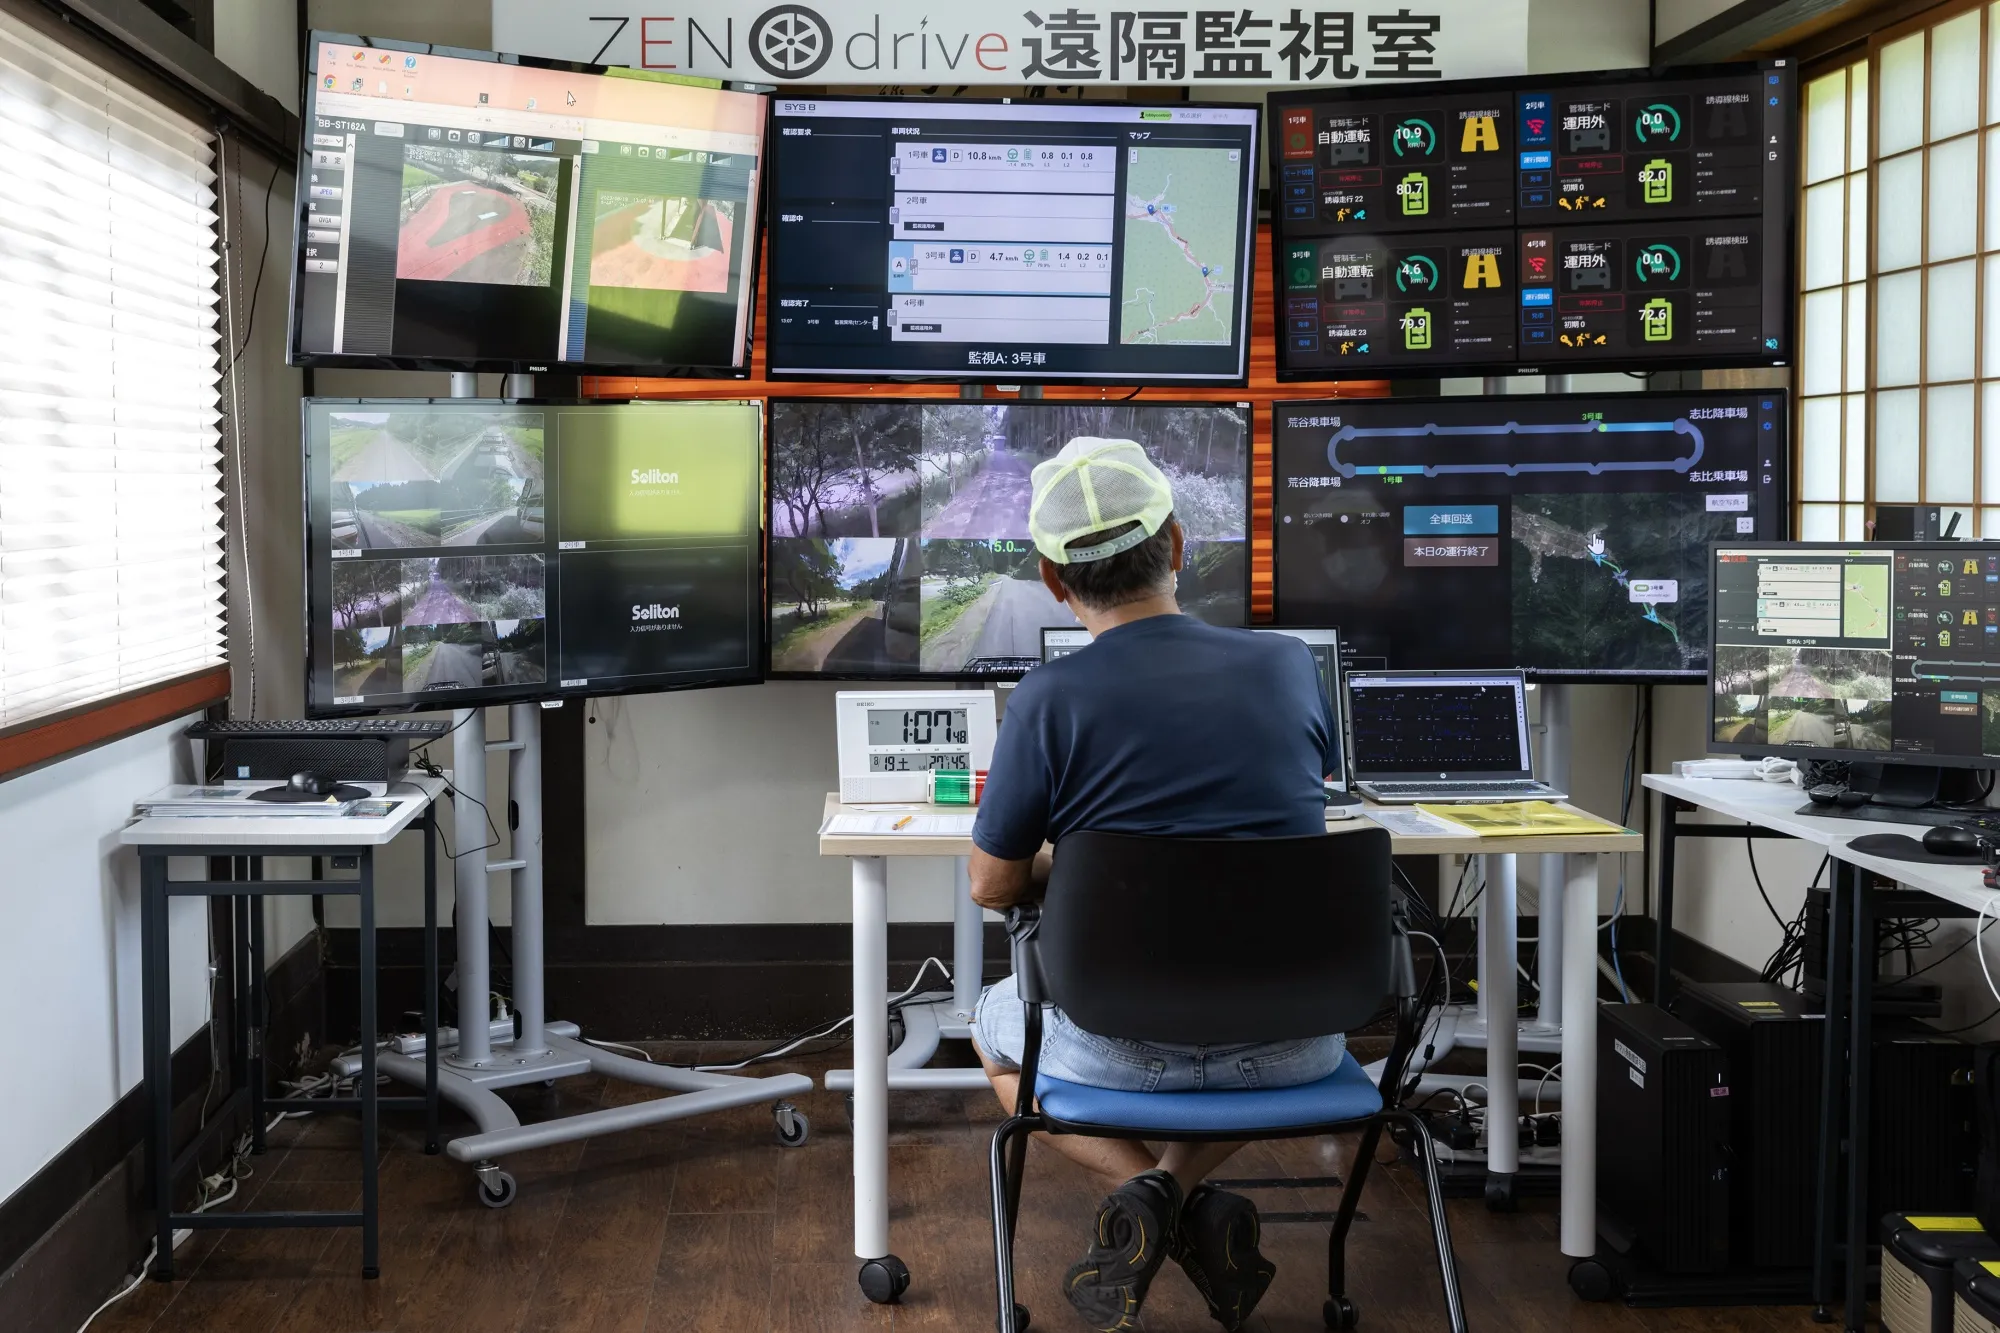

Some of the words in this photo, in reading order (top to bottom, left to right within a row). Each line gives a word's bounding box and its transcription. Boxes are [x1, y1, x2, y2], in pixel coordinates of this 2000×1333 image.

[588, 16, 733, 69] ZEN
[845, 14, 1009, 71] drive
[1021, 9, 1442, 81] 遠隔監視室
[1706, 94, 1749, 105] 誘導線検出
[784, 103, 806, 111] SYS
[1526, 102, 1545, 110] 2号車
[1569, 103, 1611, 113] 管制モード
[1288, 116, 1306, 124] 1号車
[1330, 118, 1368, 127] 管制モード
[1562, 114, 1605, 130] 運用外
[1642, 112, 1662, 125] 0.0
[318, 118, 366, 132] BB-ST162A
[1129, 132, 1151, 140] マップ
[1318, 129, 1370, 144] 自動運転
[1396, 128, 1422, 139] 10.9
[908, 150, 928, 159] 1号車
[968, 152, 987, 160] 10.8
[1041, 152, 1054, 160] 0.8
[1061, 152, 1073, 160] 0.1
[1638, 170, 1666, 182] 82.0
[320, 188, 333, 196] JPEG
[1396, 182, 1423, 195] 80.7
[1563, 184, 1578, 192] 初期
[906, 196, 927, 204] 2号車
[782, 214, 804, 222] 確認中
[1527, 240, 1546, 248] 4号車
[1706, 236, 1748, 246] 誘導線検出
[1570, 243, 1611, 252] 管制モード
[926, 252, 946, 260] 3号車
[990, 252, 1004, 261] 4.7
[1058, 252, 1070, 260] 1.4
[1077, 253, 1089, 261] 0.2
[1096, 253, 1108, 261] 0.1
[1333, 253, 1372, 262] 管制モード
[1564, 254, 1606, 269] 運用外
[1642, 253, 1662, 265] 0.0
[1322, 265, 1374, 279] 自動運転
[1402, 264, 1421, 275] 4.6
[1651, 266, 1670, 274] km/h
[904, 299, 925, 307] 4号車
[1638, 309, 1666, 321] 72.6
[1399, 318, 1426, 330] 79.9
[968, 352, 1008, 365] 監視A:
[1011, 352, 1046, 365] 3号車
[1582, 413, 1603, 421] 3号車
[1689, 407, 1748, 420] 志比降車場
[1288, 417, 1341, 428] 荒谷乗車場
[631, 468, 679, 484] Soliton
[1383, 476, 1403, 484] 1号車
[1689, 471, 1748, 482] 志比乗車場
[1288, 477, 1341, 488] 荒谷降車場
[1430, 514, 1473, 525] 全車回送
[994, 541, 1014, 552] 5.0
[1414, 546, 1489, 557] 本日の運行終了
[632, 604, 680, 620] Soliton
[630, 623, 683, 632] 入力信号がありません
[1516, 666, 1536, 674] Google
[903, 711, 951, 744] 1:07
[953, 730, 966, 744] 48
[885, 756, 895, 771] 19
[897, 757, 910, 772] 土
